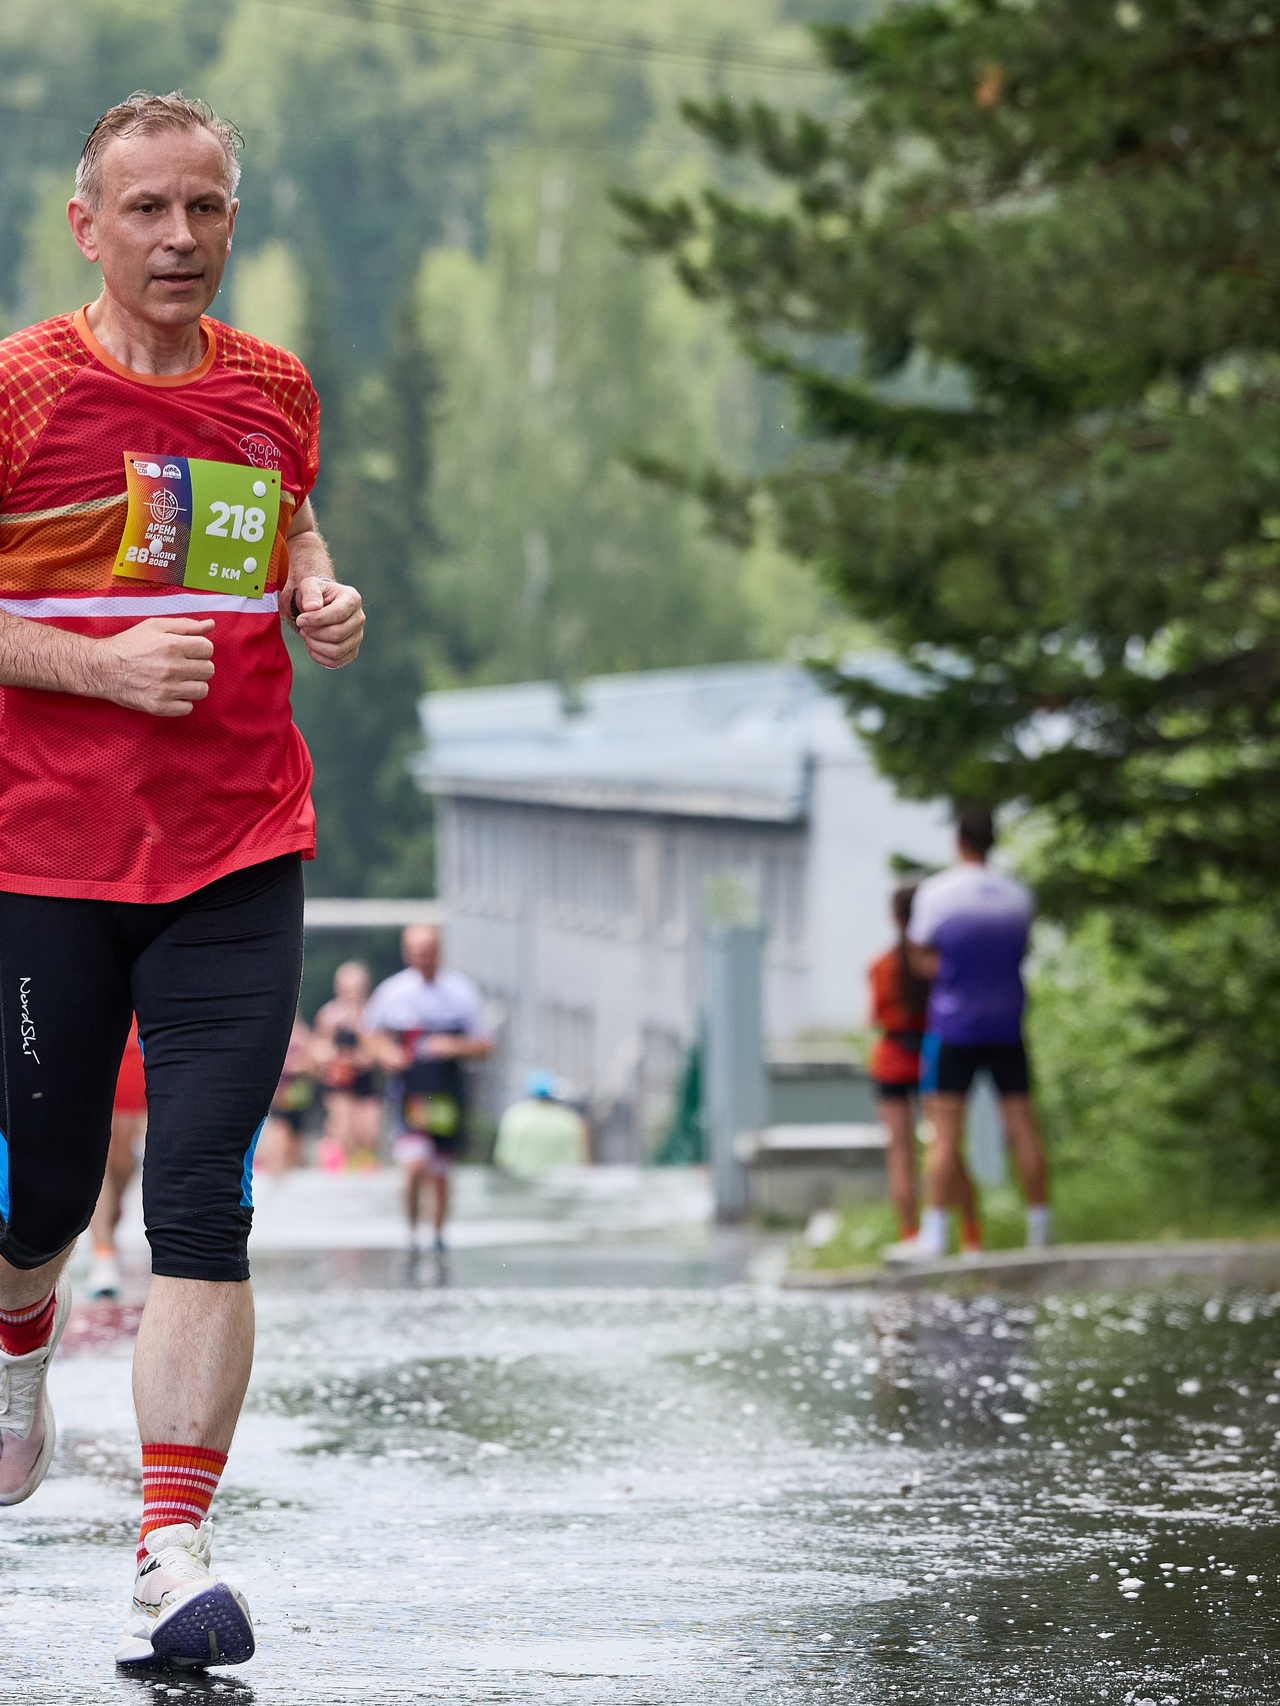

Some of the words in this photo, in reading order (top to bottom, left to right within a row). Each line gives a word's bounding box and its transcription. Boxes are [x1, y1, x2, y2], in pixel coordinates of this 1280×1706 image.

[147, 522, 177, 537] АРЕНА
[205, 501, 266, 543] 218
[124, 546, 150, 564] 28
[208, 562, 219, 577] 5
[221, 567, 242, 580] КМ
